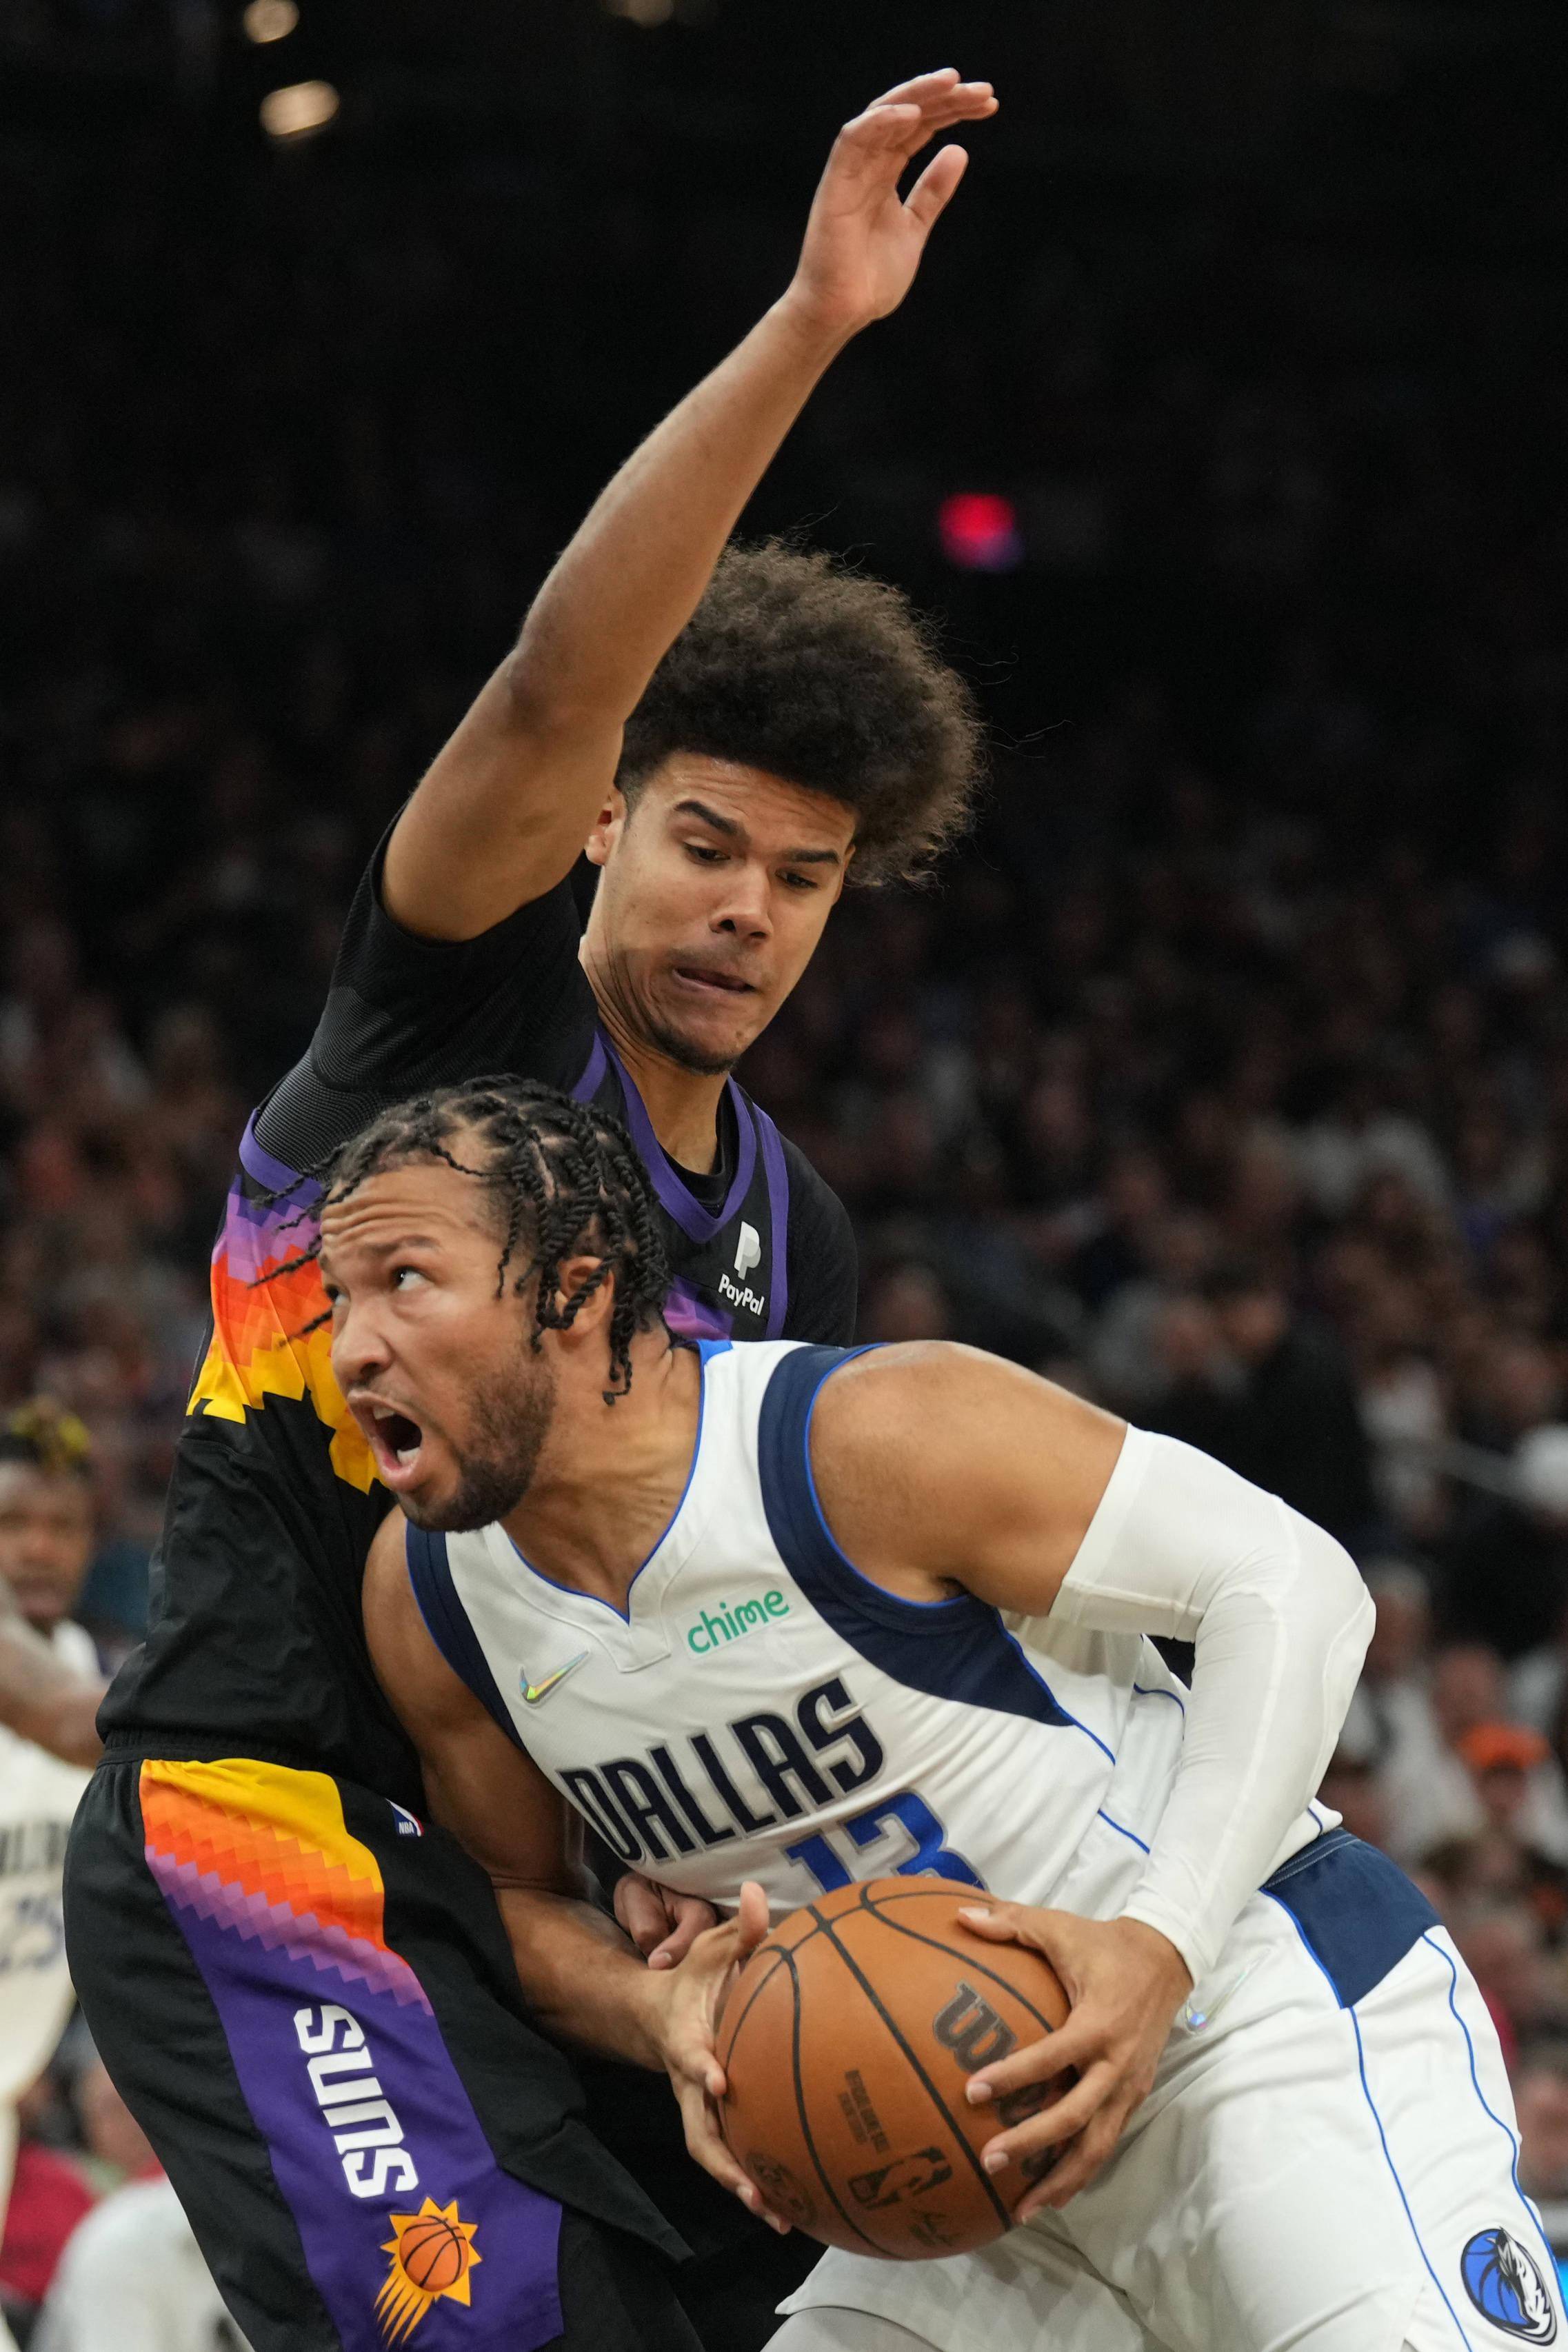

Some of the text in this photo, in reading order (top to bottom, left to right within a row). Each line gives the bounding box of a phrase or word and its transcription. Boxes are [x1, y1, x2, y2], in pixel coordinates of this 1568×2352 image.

[718, 1274, 765, 1315] PayPal
[686, 1589, 790, 1654] chime
[556, 1675, 885, 1863] DALLAS
[399, 1821, 414, 1834] NBA
[294, 2004, 419, 2199] SUNS
